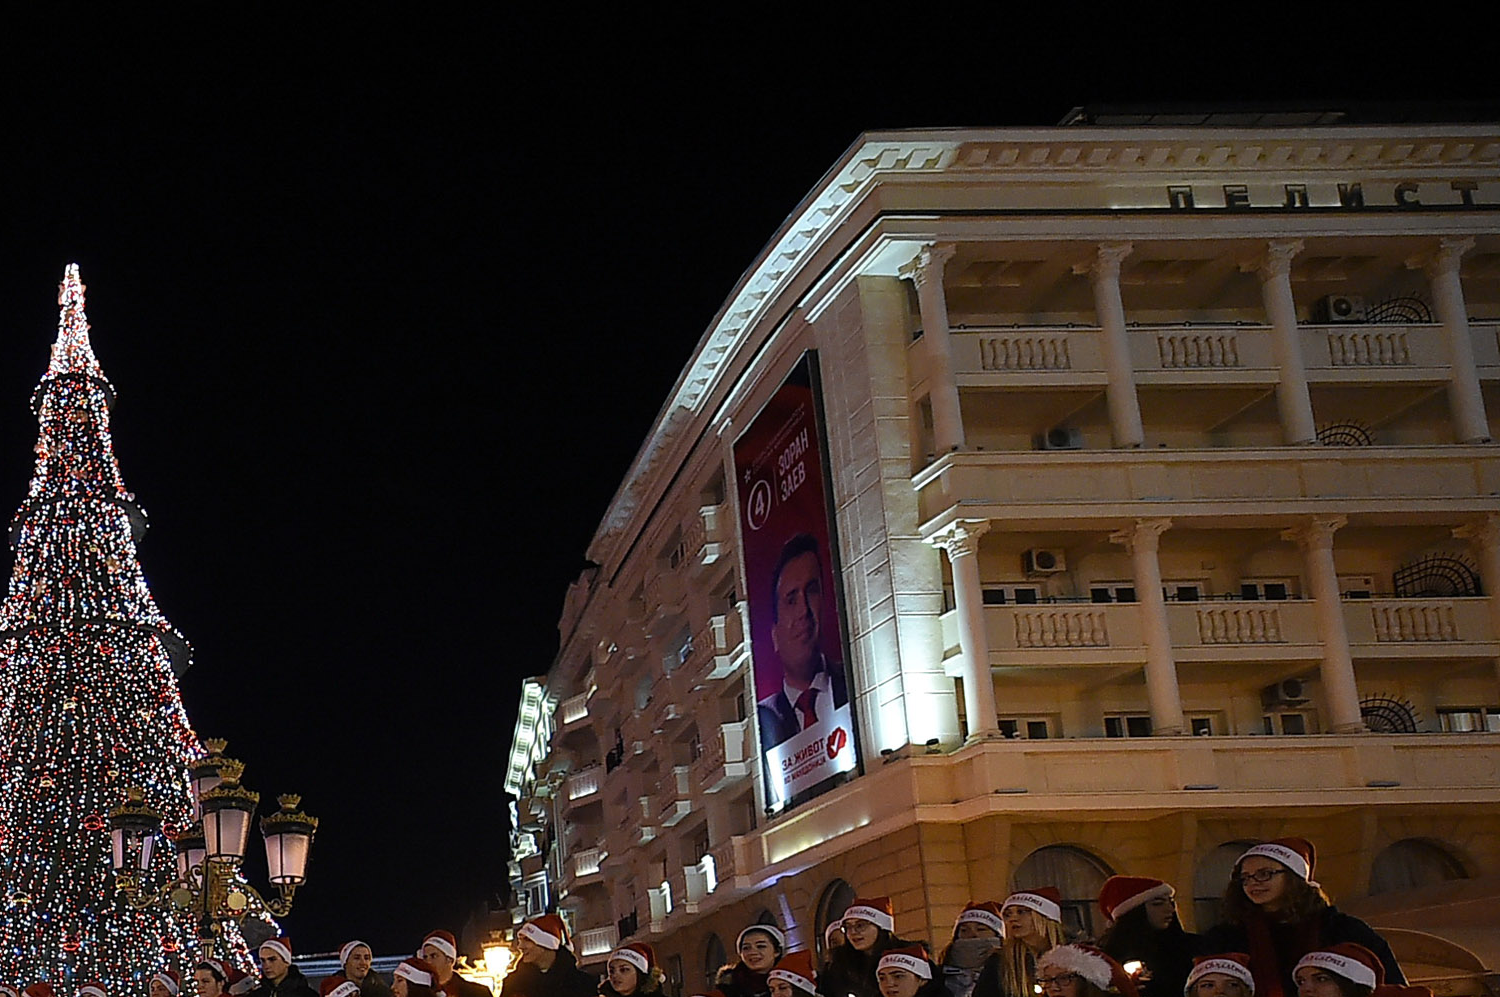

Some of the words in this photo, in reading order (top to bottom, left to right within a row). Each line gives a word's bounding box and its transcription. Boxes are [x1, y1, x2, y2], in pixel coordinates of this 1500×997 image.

[778, 427, 808, 476] ЗОРАН
[780, 460, 806, 502] ЗАЕВ
[754, 489, 765, 516] 4
